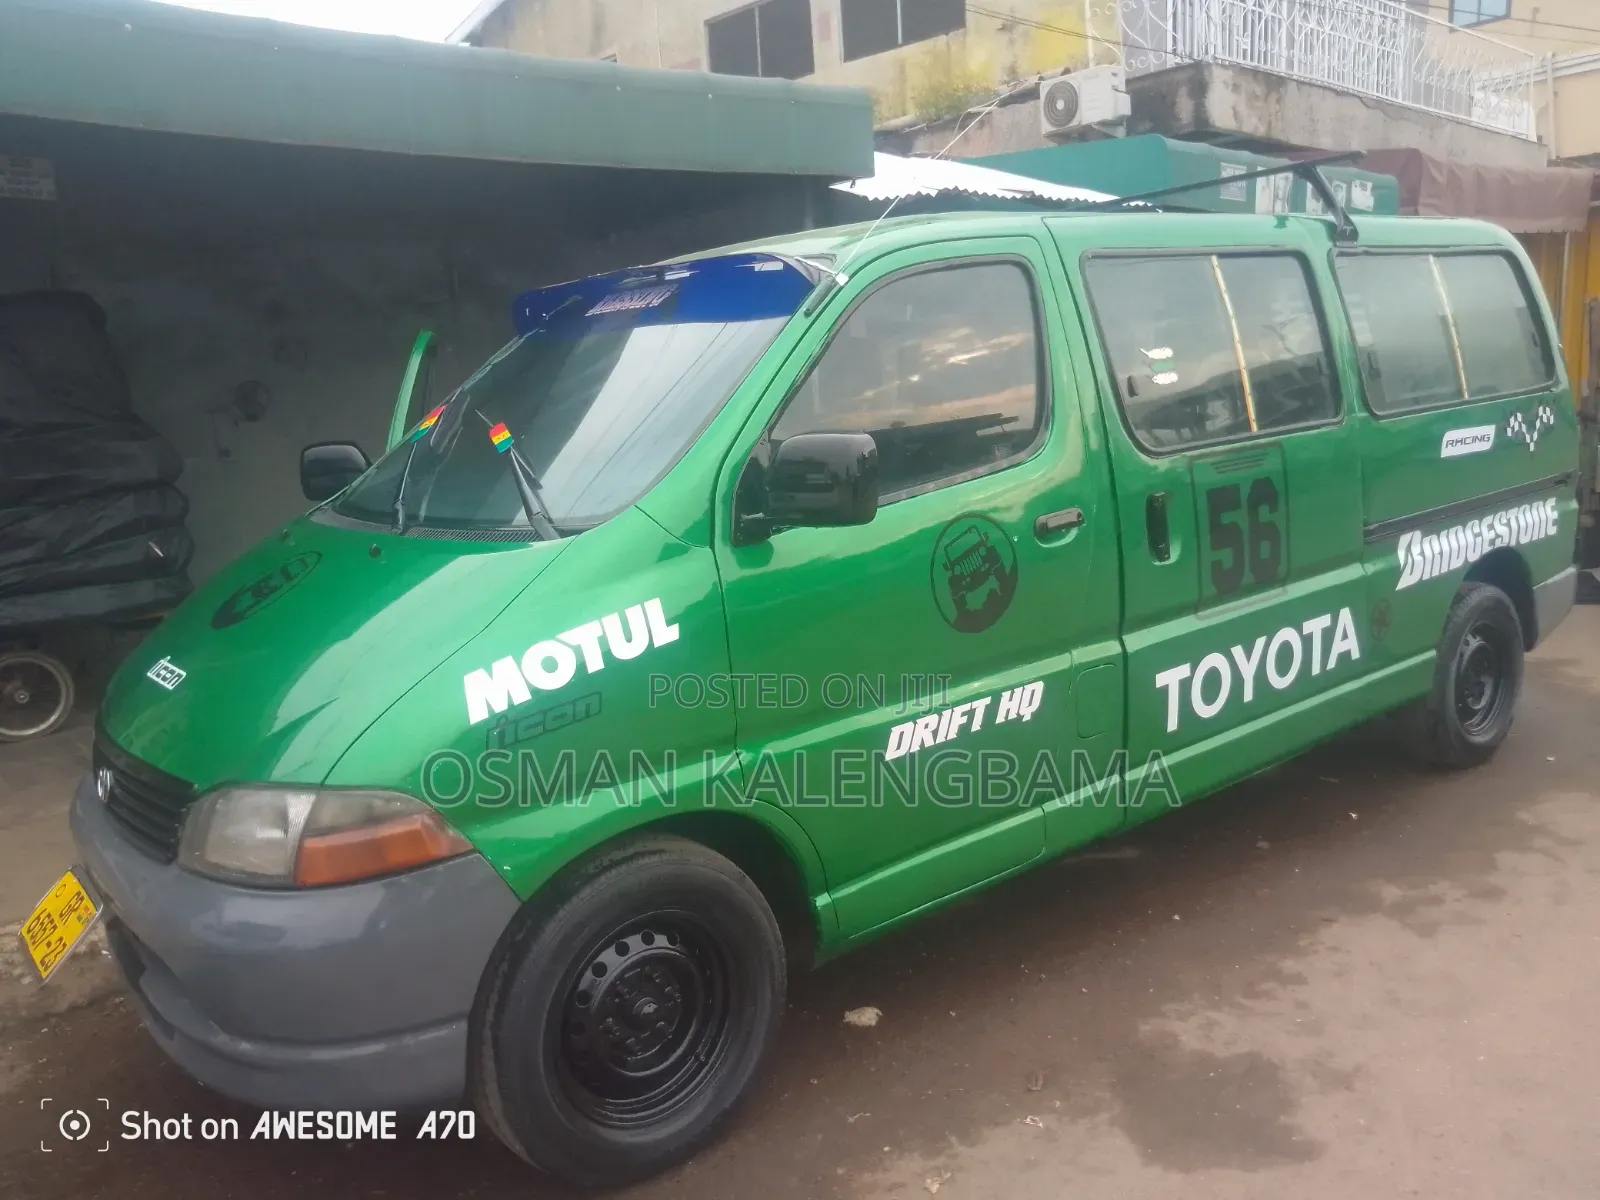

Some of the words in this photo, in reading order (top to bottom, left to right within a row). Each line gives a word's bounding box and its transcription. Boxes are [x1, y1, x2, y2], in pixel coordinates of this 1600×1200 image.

[1445, 433, 1491, 449] RACING
[1206, 476, 1281, 595] 56
[1395, 497, 1559, 591] BRIDGESTONE
[463, 597, 680, 725] MOTUL
[1155, 606, 1361, 733] TOYOTA
[884, 696, 992, 762] DRIFT
[995, 680, 1045, 724] HQ
[59, 890, 86, 926] GR
